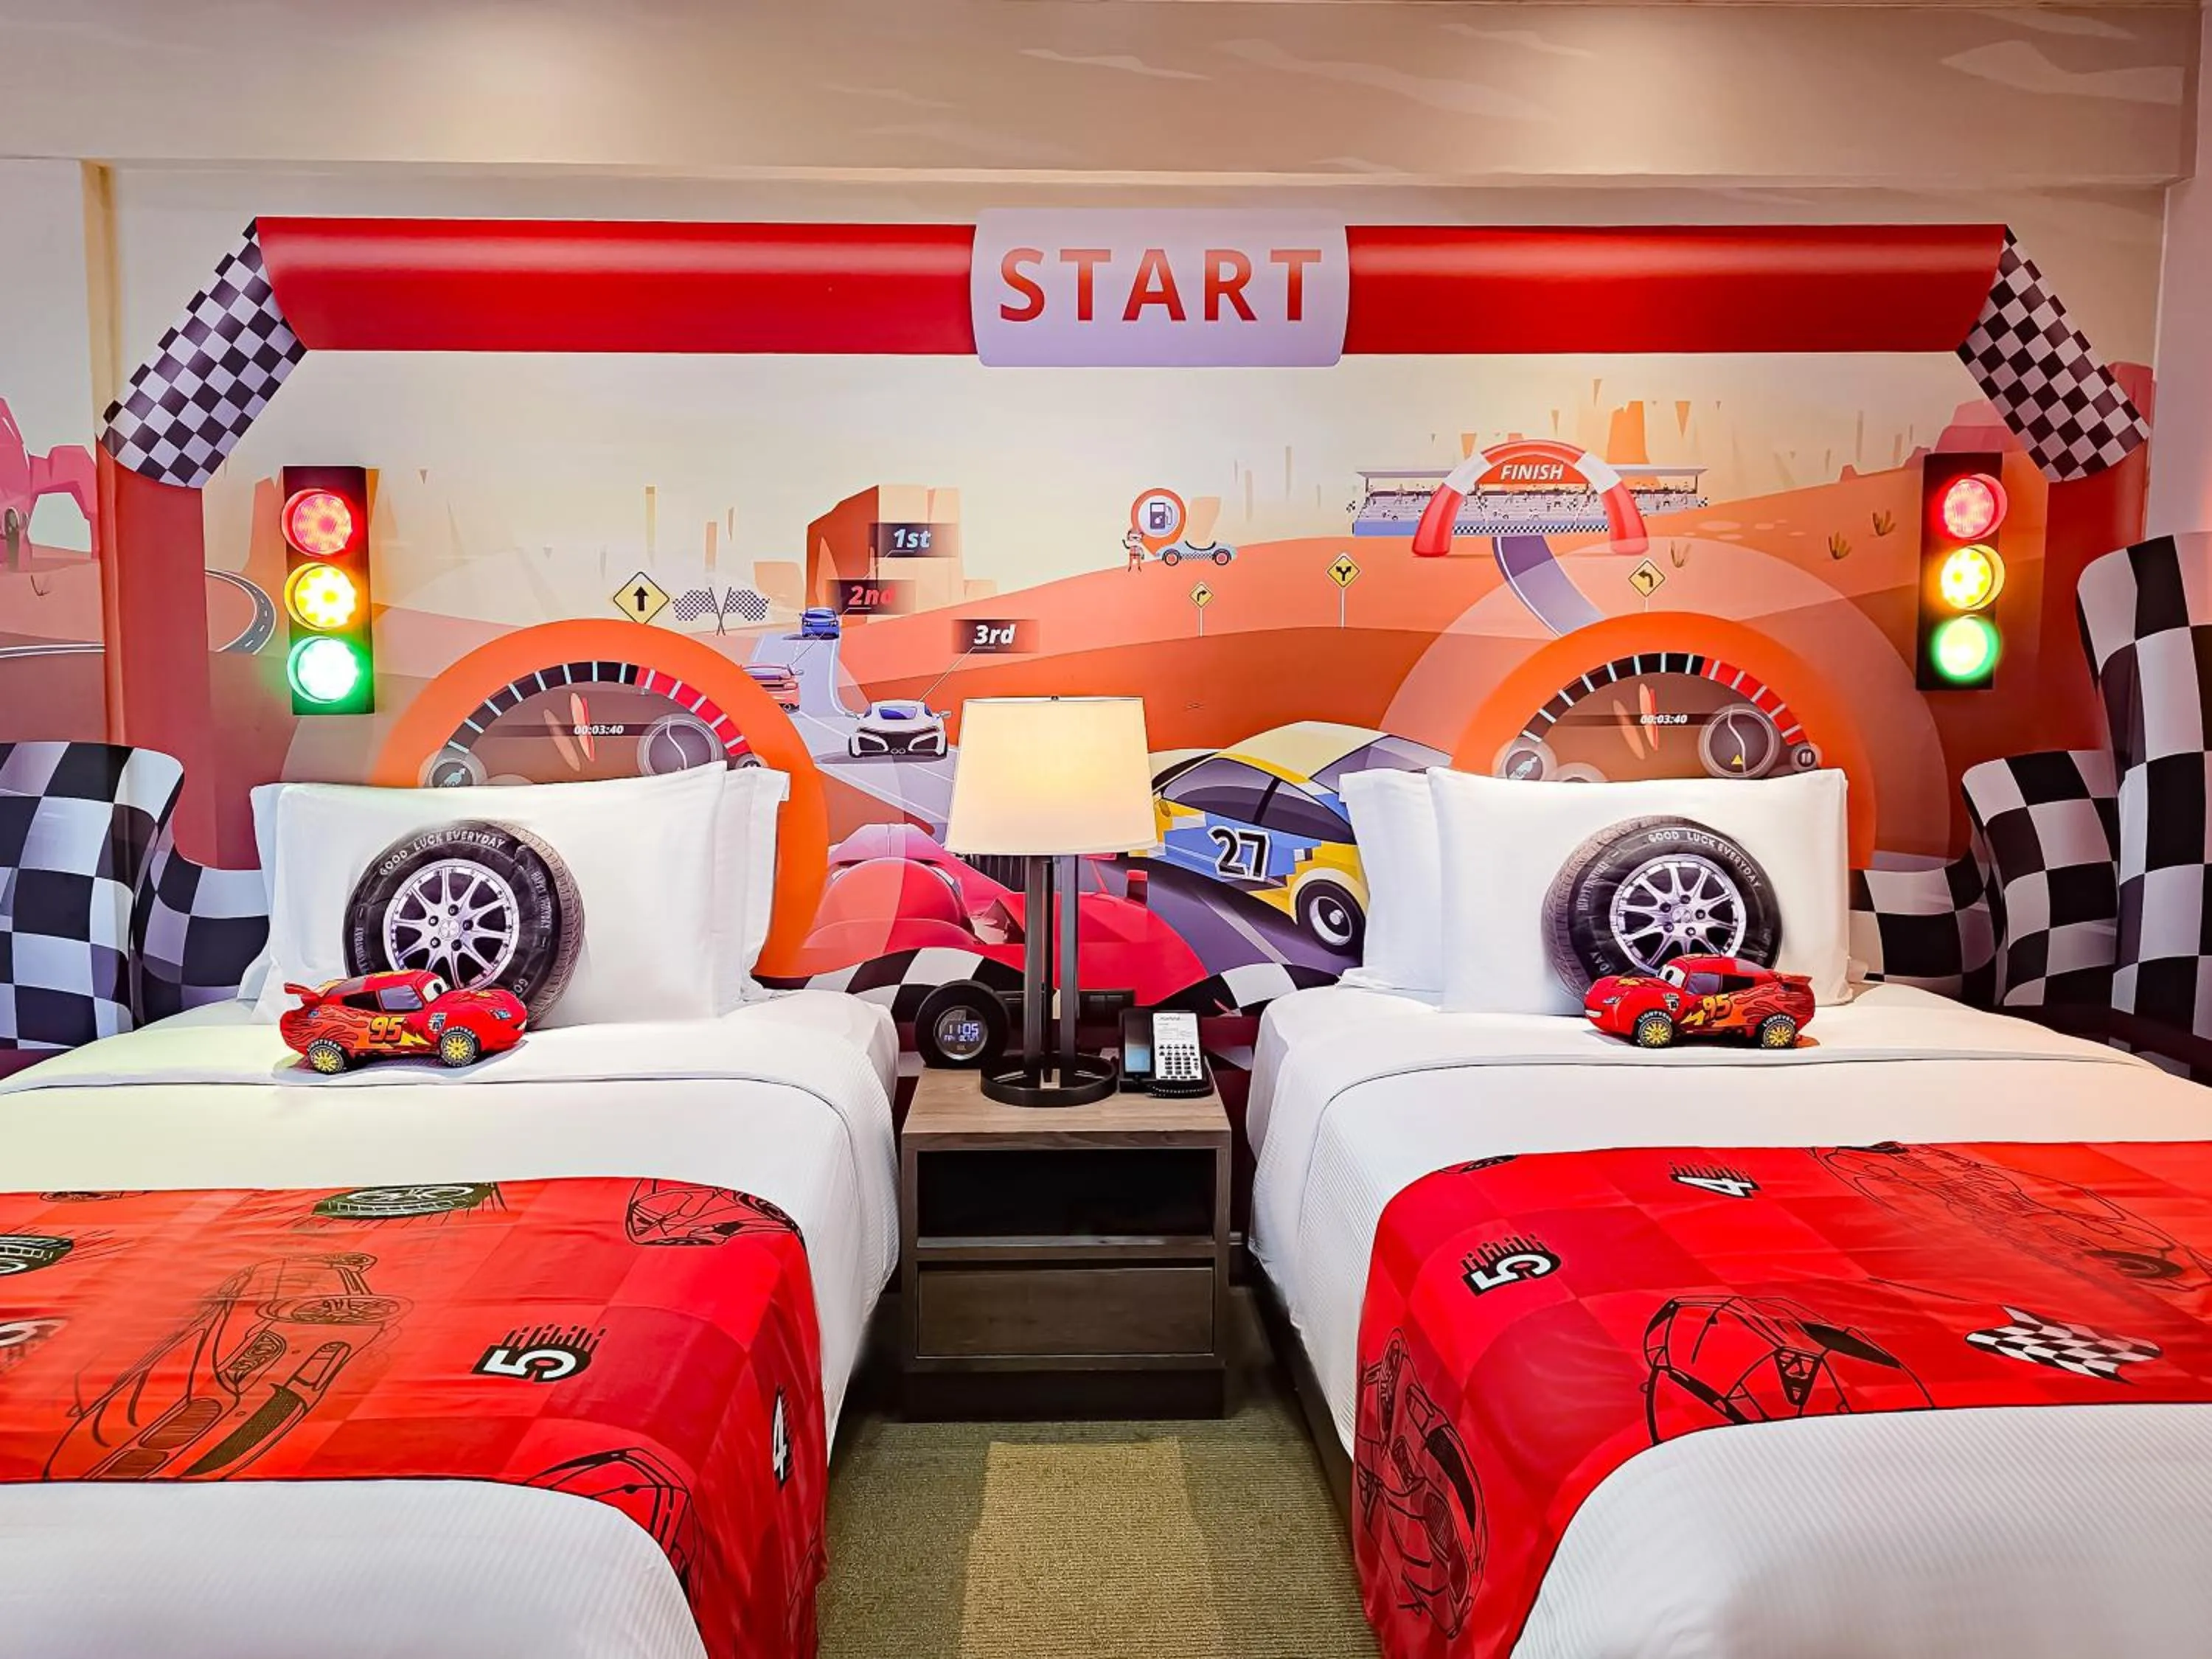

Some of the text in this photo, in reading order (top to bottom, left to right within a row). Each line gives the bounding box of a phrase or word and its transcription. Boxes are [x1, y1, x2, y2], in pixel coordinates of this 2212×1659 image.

[1000, 248, 1321, 322] START
[1500, 464, 1564, 480] FINISH
[894, 529, 931, 548] 1st
[848, 585, 897, 605] 2nd
[973, 624, 1016, 644] 3rd
[574, 725, 625, 735] 00:03:40
[1640, 714, 1688, 725] 00:03:40
[379, 830, 506, 876] GOOD LUCK EVERYDAY
[1208, 826, 1268, 880] 27
[1648, 831, 1761, 888] GOOD LUCK EVERYDAY
[1703, 994, 1732, 1020] 95
[370, 1017, 405, 1040] 95
[1674, 1175, 1757, 1198] 4
[1467, 1251, 1555, 1293] 5
[479, 1348, 582, 1380] 5
[772, 1393, 789, 1483] 4
